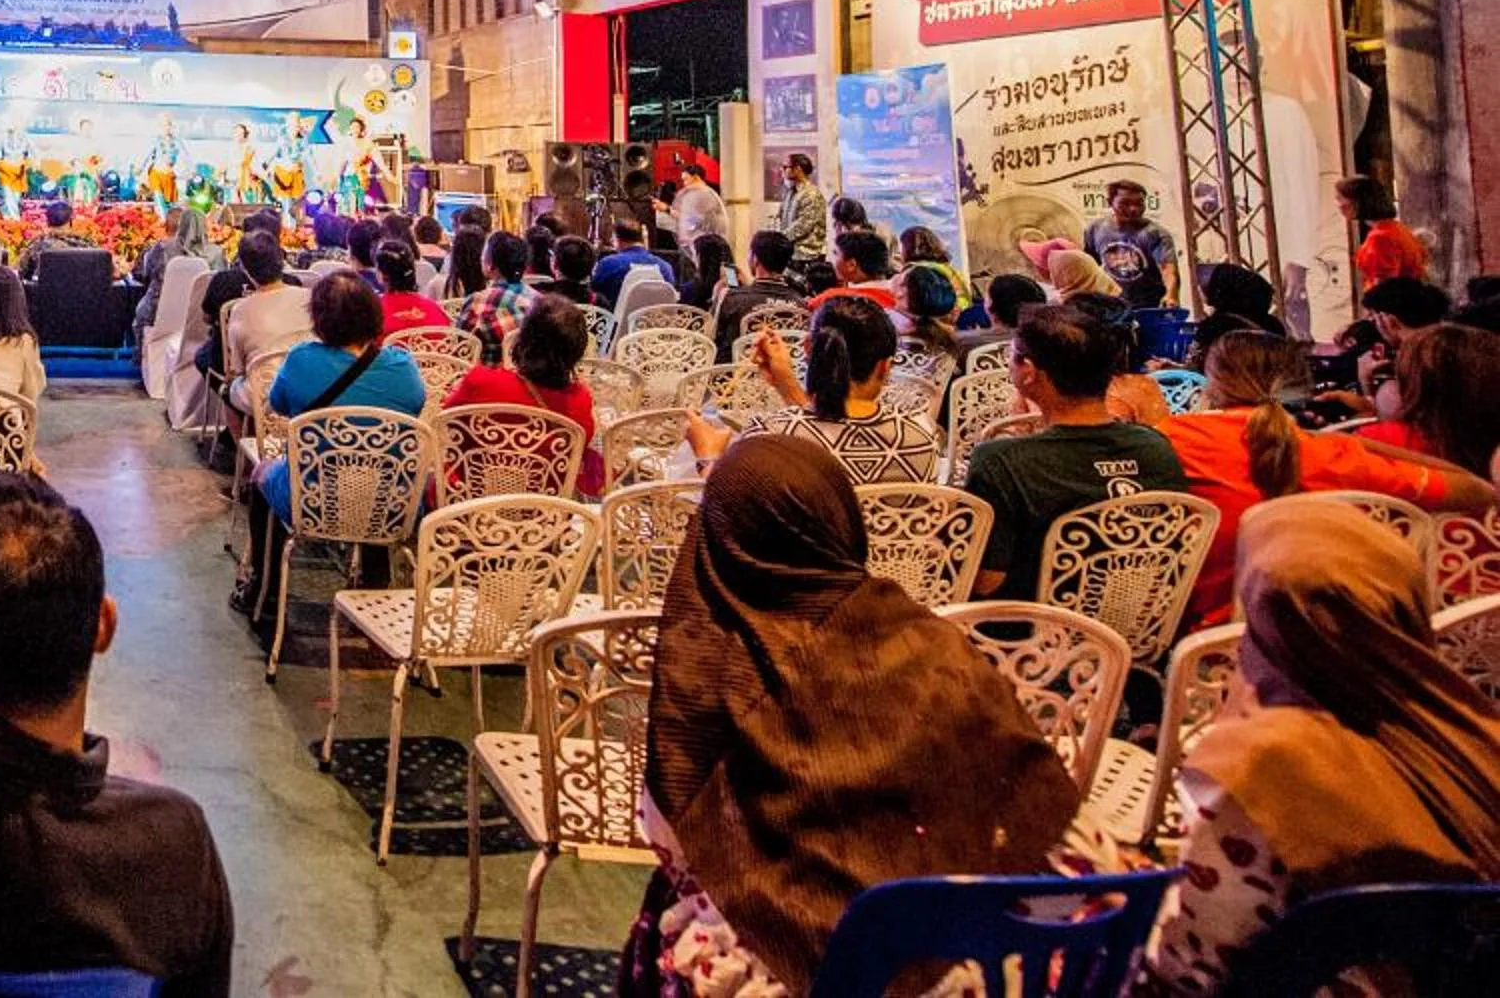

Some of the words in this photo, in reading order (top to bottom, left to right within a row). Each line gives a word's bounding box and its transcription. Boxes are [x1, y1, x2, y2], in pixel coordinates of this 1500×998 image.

[983, 45, 1131, 110] ร่วมอนุรักษ์
[991, 117, 1141, 180] สุนทราภรณ์
[1094, 459, 1139, 477] TEAM
